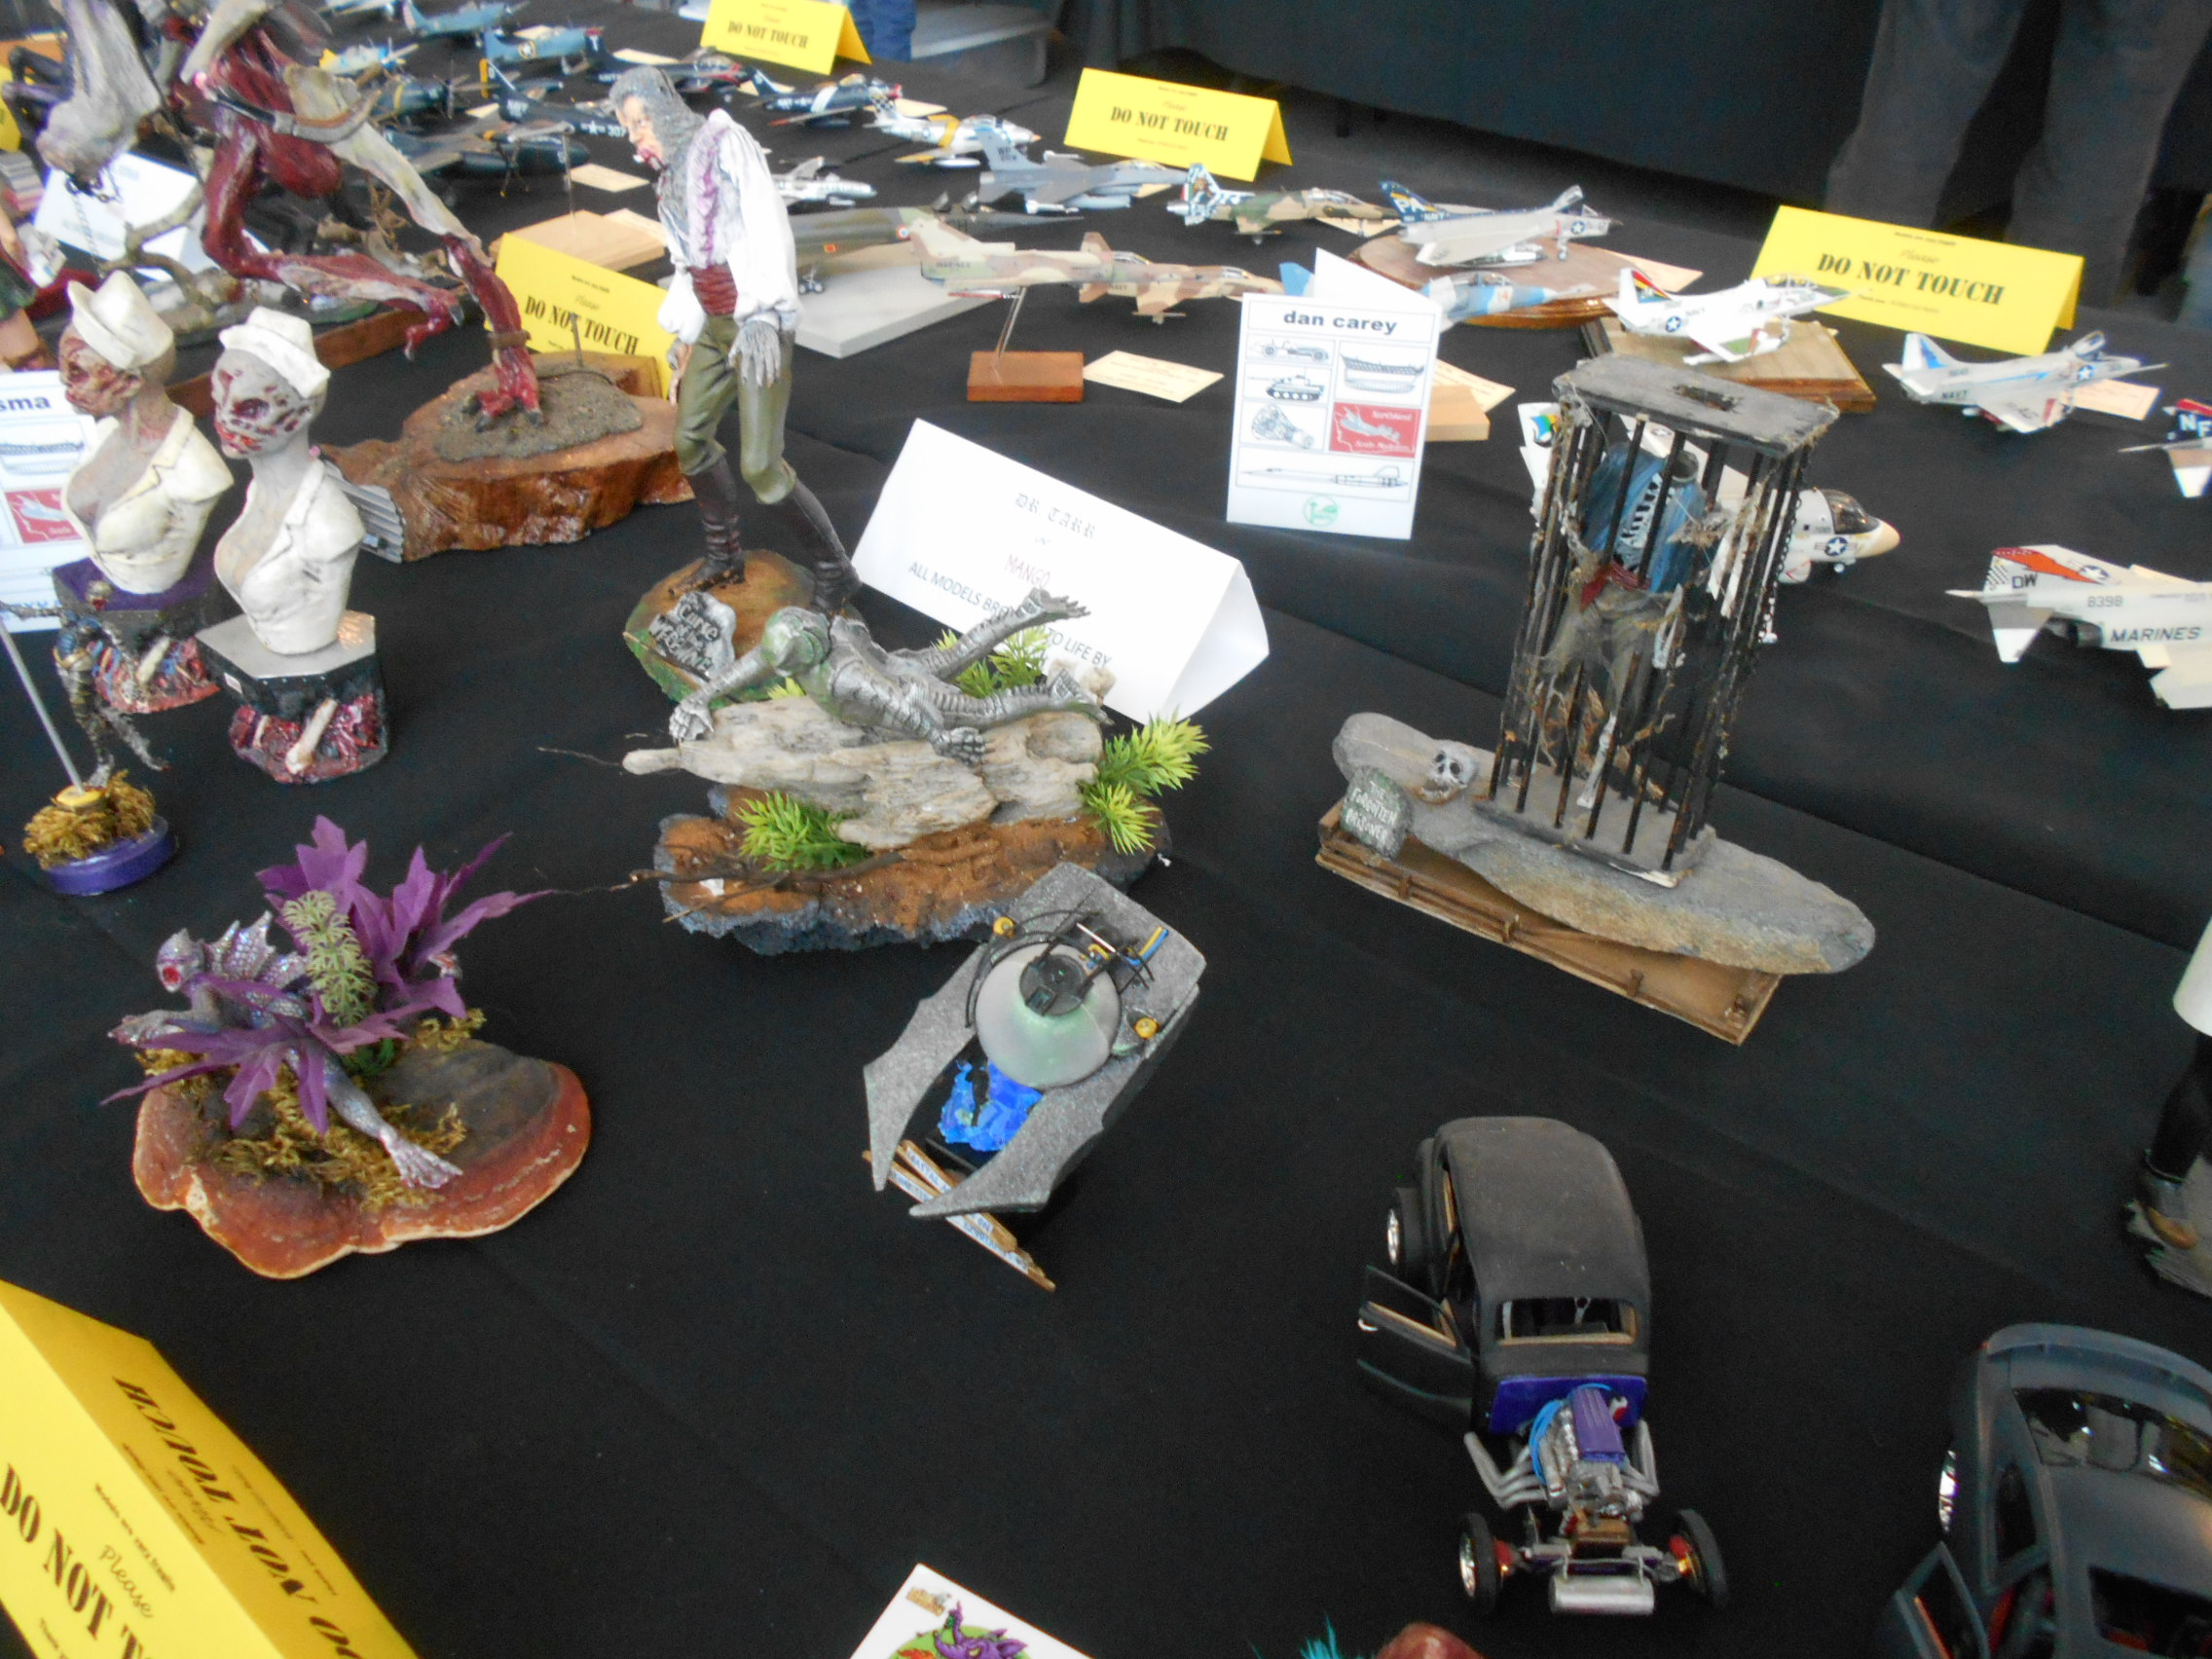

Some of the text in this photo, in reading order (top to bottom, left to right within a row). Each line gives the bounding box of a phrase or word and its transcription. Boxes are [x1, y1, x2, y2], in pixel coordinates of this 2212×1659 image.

[727, 20, 809, 49] DO NOT TOUCH
[1111, 106, 1230, 141] DO NOT TOUCH
[1817, 253, 1852, 276] DO
[1858, 261, 1910, 286] NOT
[1915, 271, 2006, 306] TOUCH
[525, 295, 545, 319] DO
[584, 318, 640, 354] TOUCH
[1283, 311, 1398, 336] dan carey
[1015, 493, 1040, 514] DR
[908, 561, 981, 607] ALL MODELS
[1064, 635, 1093, 660] LIFE
[1091, 647, 1113, 669] BY
[2111, 627, 2202, 643] MARINES
[112, 1376, 239, 1504] TOUCH
[0, 1463, 114, 1641] DO NOT
[222, 1514, 319, 1604] NOT
[99, 1544, 154, 1618] Please
